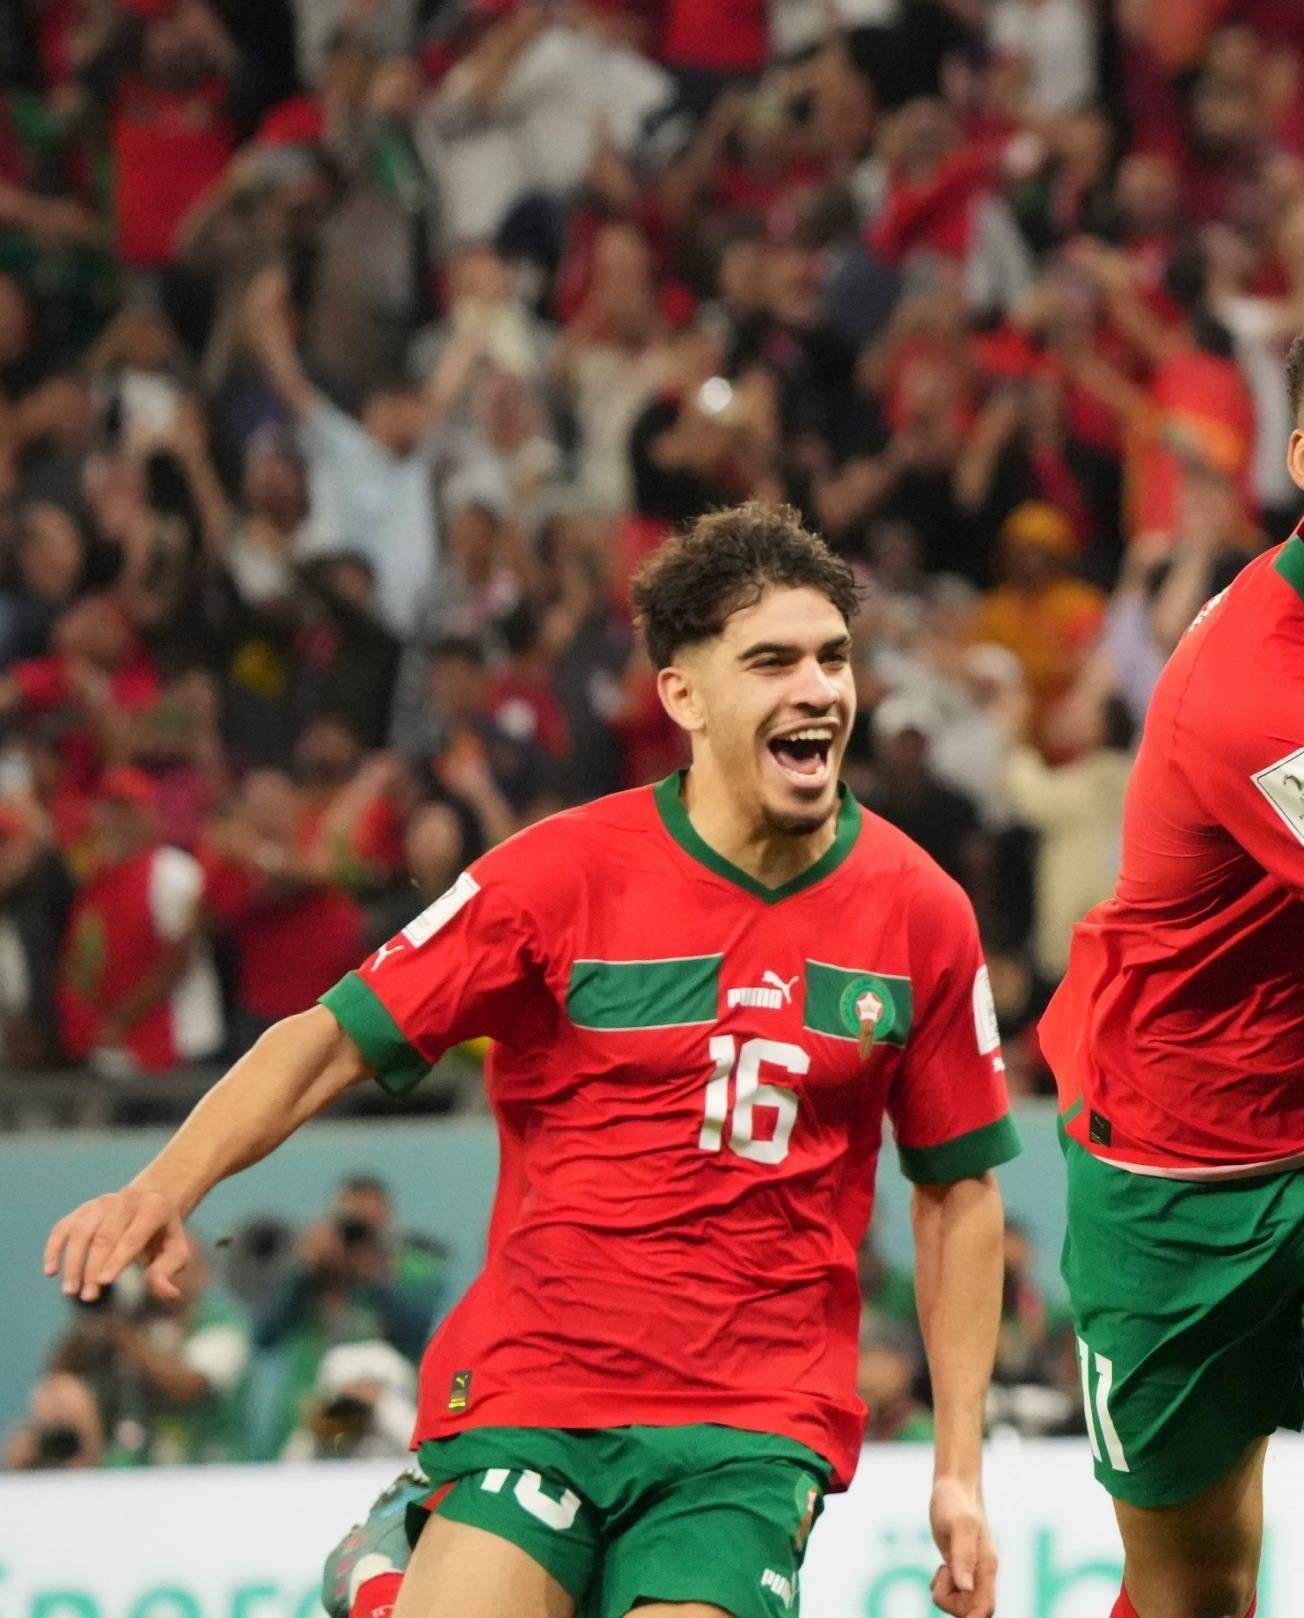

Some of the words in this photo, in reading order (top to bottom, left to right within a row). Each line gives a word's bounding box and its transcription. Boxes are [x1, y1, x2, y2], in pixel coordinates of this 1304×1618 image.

[728, 987, 782, 1009] PUMA
[699, 1035, 810, 1164] 16
[1077, 1336, 1130, 1472] 11
